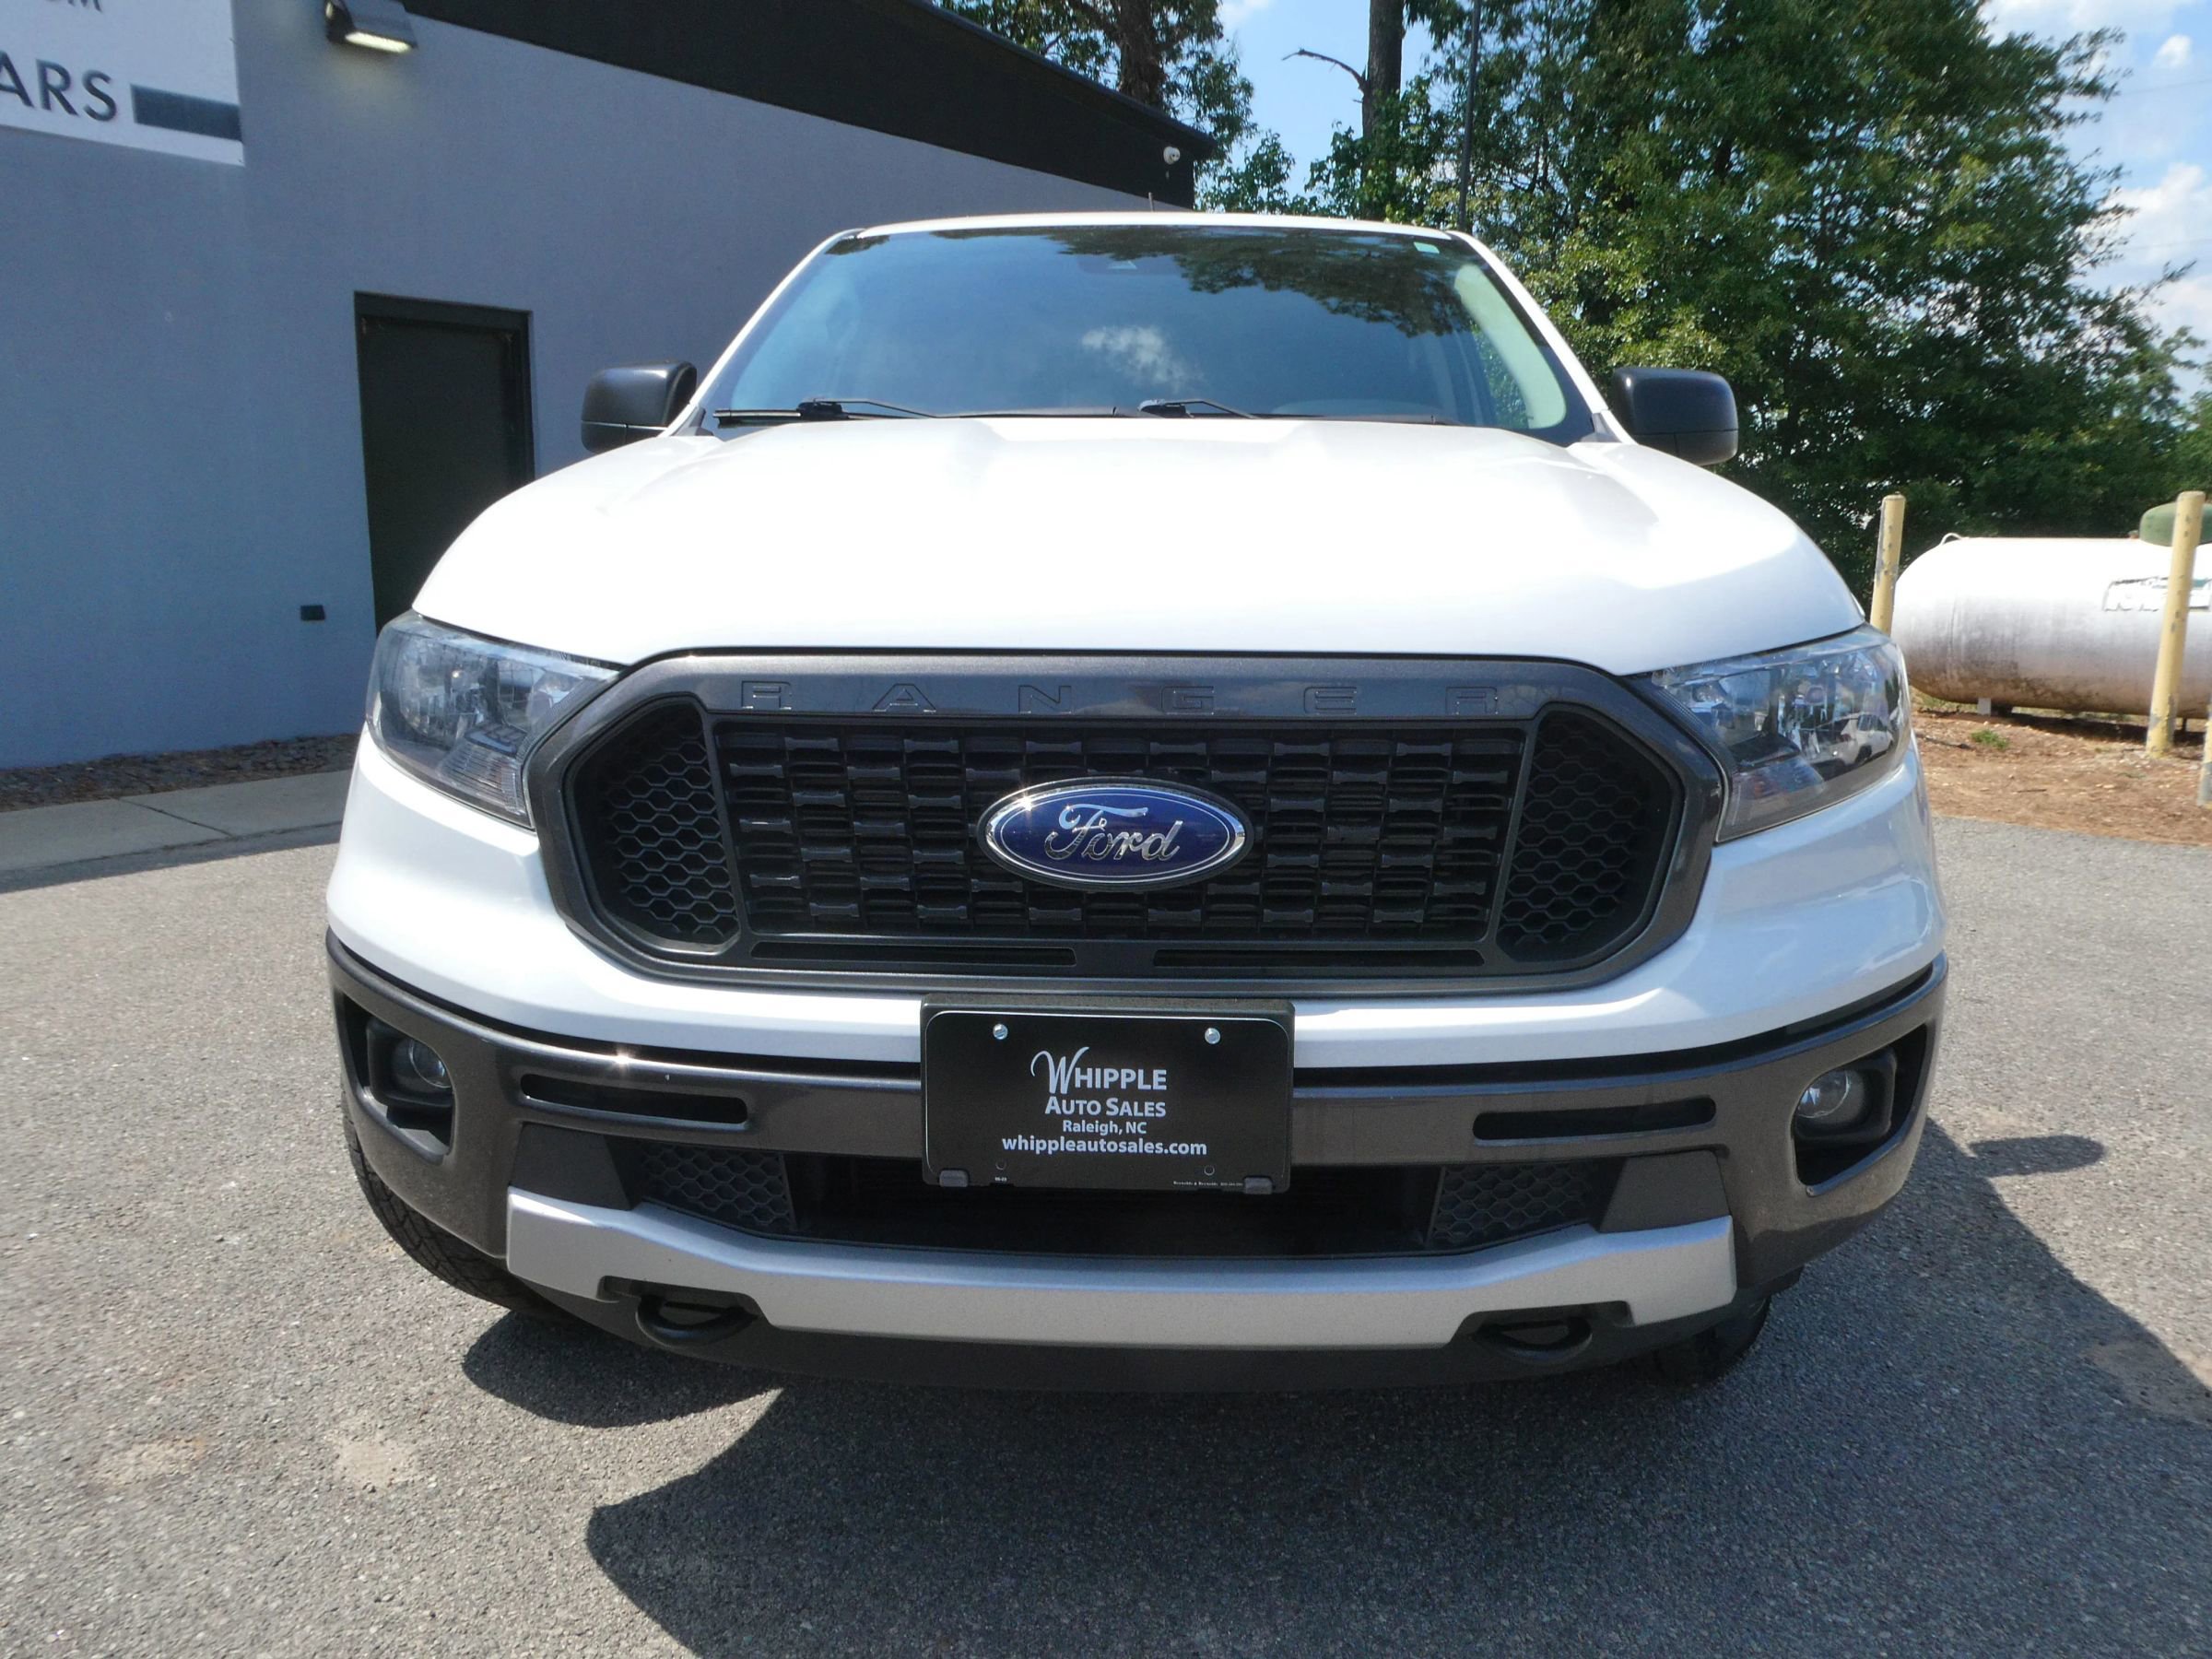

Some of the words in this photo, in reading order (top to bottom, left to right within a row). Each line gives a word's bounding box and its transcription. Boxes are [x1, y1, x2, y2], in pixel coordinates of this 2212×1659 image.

[740, 679, 1499, 716] RANGER
[1043, 803, 1183, 862] Ford
[1062, 1119, 1124, 1136] Raleigh,
[1125, 1121, 1147, 1135] NC
[1002, 1135, 1207, 1155] whippleautosales.com
